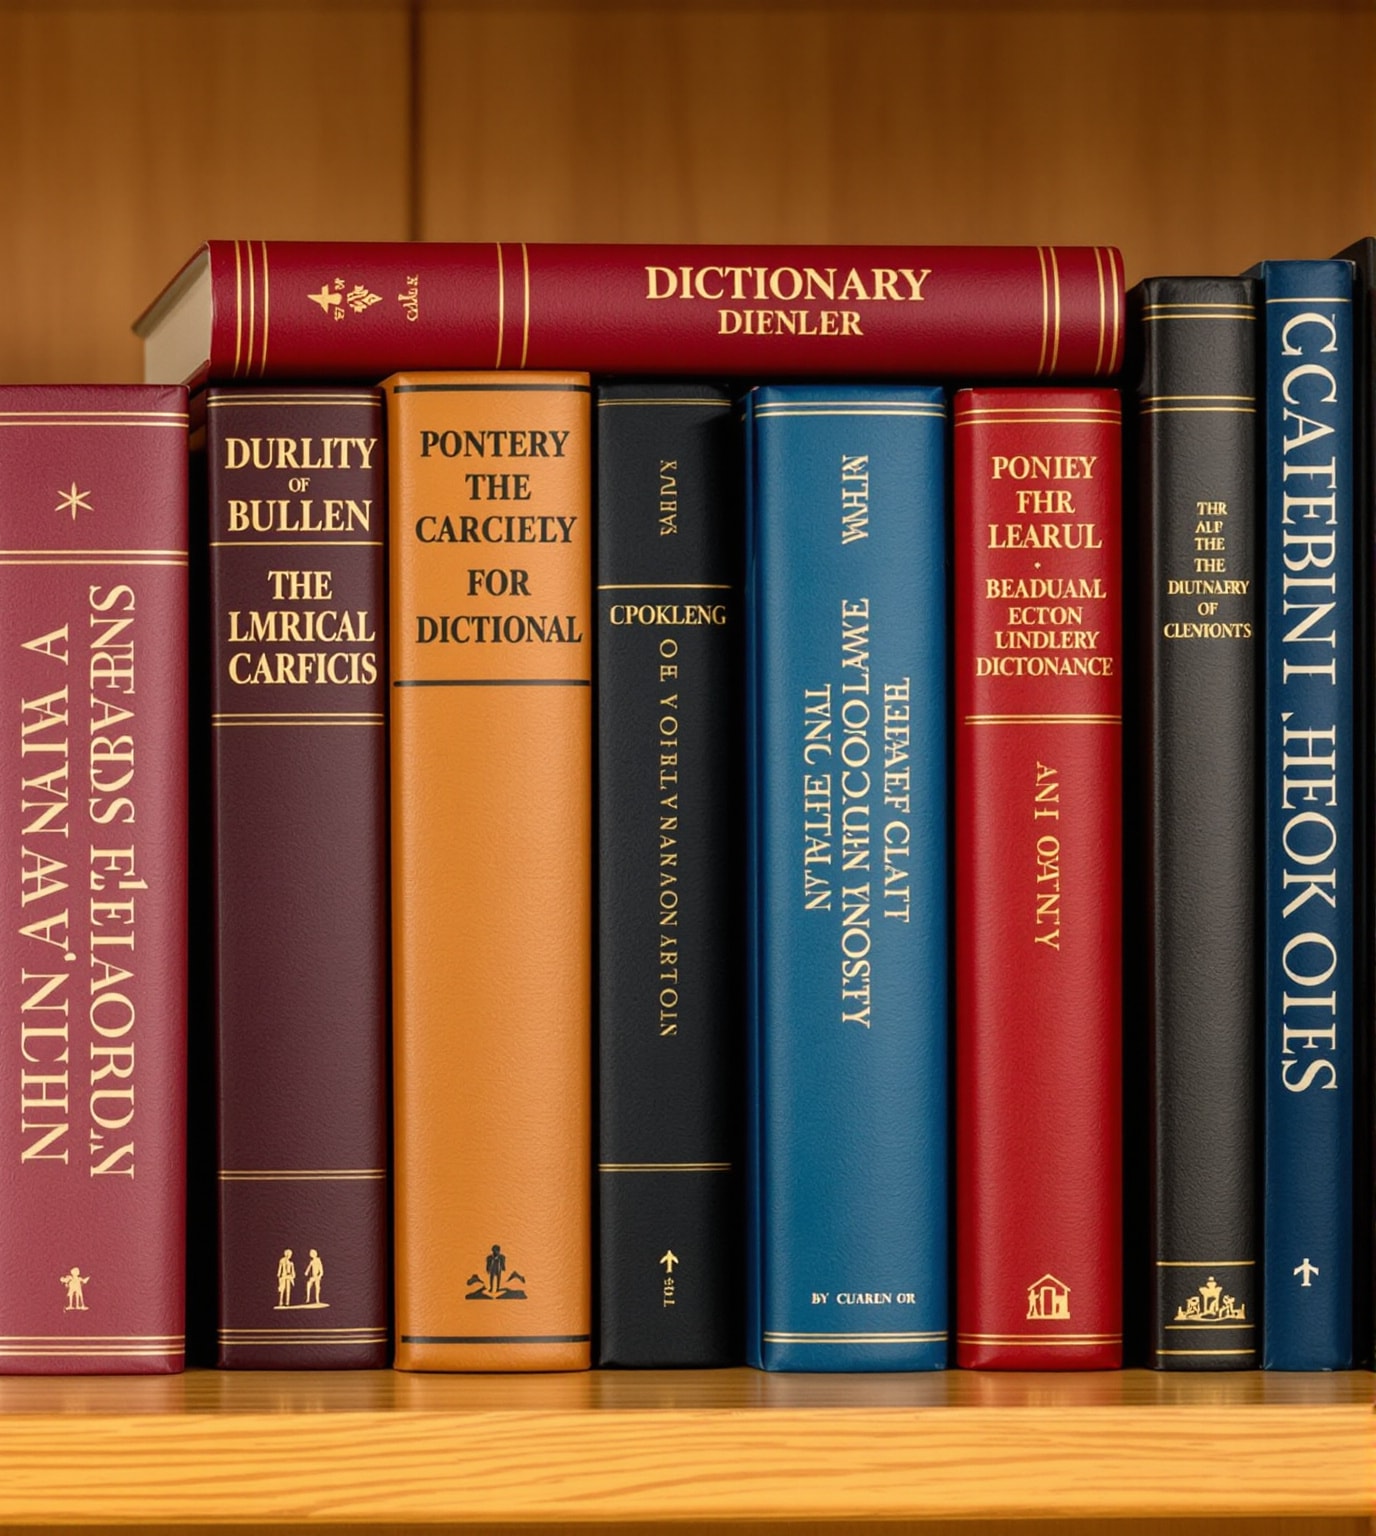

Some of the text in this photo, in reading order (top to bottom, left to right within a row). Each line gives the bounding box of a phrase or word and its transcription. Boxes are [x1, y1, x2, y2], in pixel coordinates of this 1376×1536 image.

[644, 265, 931, 301] DICTIONARY
[717, 309, 863, 336] DIENLER
[224, 437, 377, 469] DURLITY
[420, 430, 570, 457] PONTERY
[288, 477, 310, 492] OF
[465, 474, 532, 500] THE
[1016, 490, 1076, 513] FHR
[228, 500, 372, 532] BULLEN
[988, 524, 1102, 549] LEARUL
[1194, 537, 1225, 550] THE
[1194, 558, 1226, 572] THE
[267, 571, 333, 600] THE
[467, 569, 532, 596] FOR
[1008, 606, 1083, 625] ECTON
[1197, 602, 1219, 615] OF
[228, 611, 376, 642] LMRICAL
[415, 615, 583, 643] DICTIONAL
[228, 653, 377, 684] CARFICIS
[976, 657, 1114, 676] DICTONANCE
